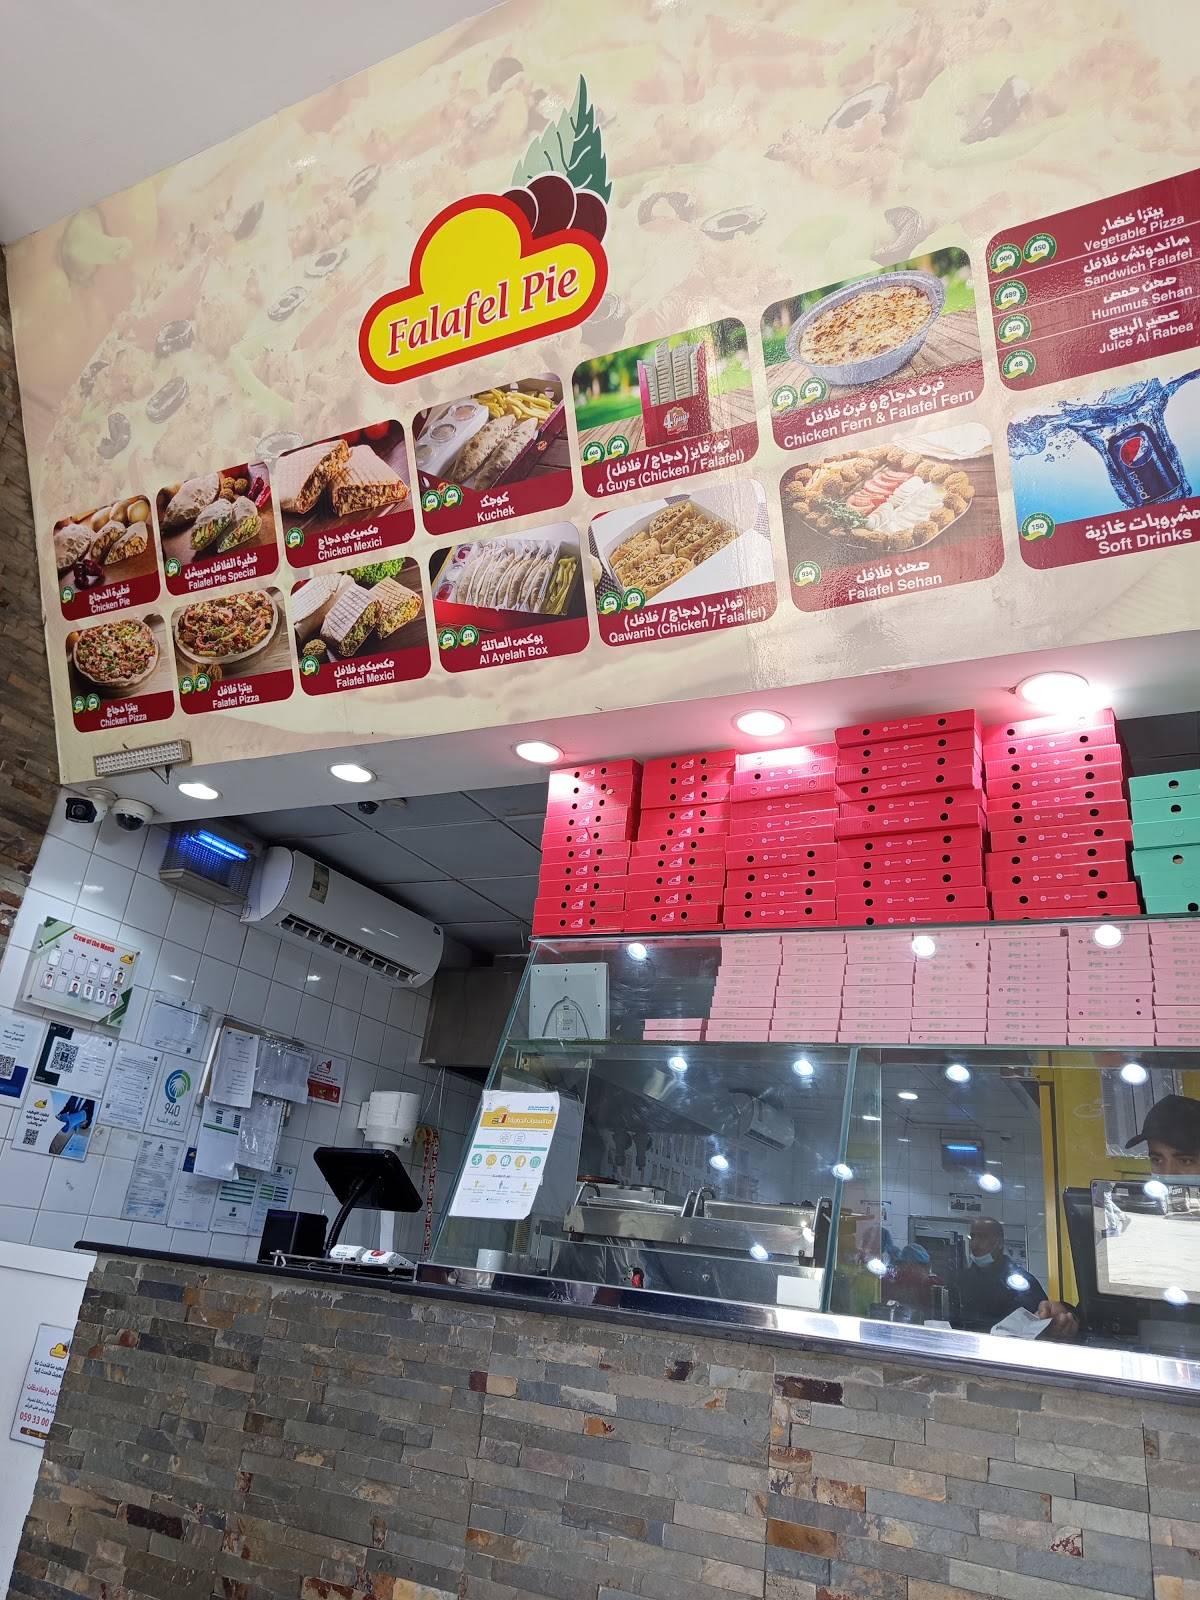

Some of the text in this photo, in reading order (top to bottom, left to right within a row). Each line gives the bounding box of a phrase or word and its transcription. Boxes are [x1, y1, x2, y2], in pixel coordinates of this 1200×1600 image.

[1100, 206, 1164, 236] بيتزا خضار
[1084, 215, 1185, 250] Vegetable Pizza
[1083, 252, 1120, 274] فلافل
[1084, 247, 1192, 287] Sandwich Falafel
[1104, 276, 1176, 304] صحن حمص
[387, 265, 579, 356] Falafel Pie
[1092, 286, 1192, 320] Hummus Sehan
[1109, 310, 1180, 340] عصير الربيع
[1100, 322, 1194, 354] Juice Al Rabea
[919, 376, 944, 396] فرن
[880, 389, 916, 410] دجاج
[784, 389, 974, 448] Chicken Fern & Falafel Fern
[806, 406, 840, 426] فلافل
[597, 449, 745, 494] 4 Guys (Chicken / Falafel)
[477, 505, 515, 522] Kuchek
[318, 525, 378, 550] مكسيكي دجاج
[1086, 518, 1126, 542] غازية
[1098, 528, 1192, 554] Soft Drinks
[318, 536, 382, 560] Chicken Mexici
[236, 553, 258, 568] فطيرة
[188, 566, 256, 590] Falafel Pie Special
[856, 561, 930, 584] صحن فلافل
[848, 574, 942, 602] Falafel Sehan
[91, 598, 130, 613] Chicken Pie
[708, 596, 744, 613] قوارب
[609, 608, 766, 644] Qawarib (Chicken / Falafel)
[512, 633, 544, 646] بوكس
[480, 646, 548, 664] Al Ayelah Box
[334, 658, 394, 678] مكسيكي فلافل
[336, 670, 395, 688] Falafel Mexici
[218, 683, 252, 696] بيتزا فلافل
[107, 706, 124, 717] دجاج
[213, 694, 260, 708] Falafel Pizza
[100, 714, 147, 728] Chicken Pizza
[72, 933, 86, 943] Crew
[92, 940, 100, 948] the
[100, 943, 116, 953] Month
[164, 1102, 180, 1117] 940
